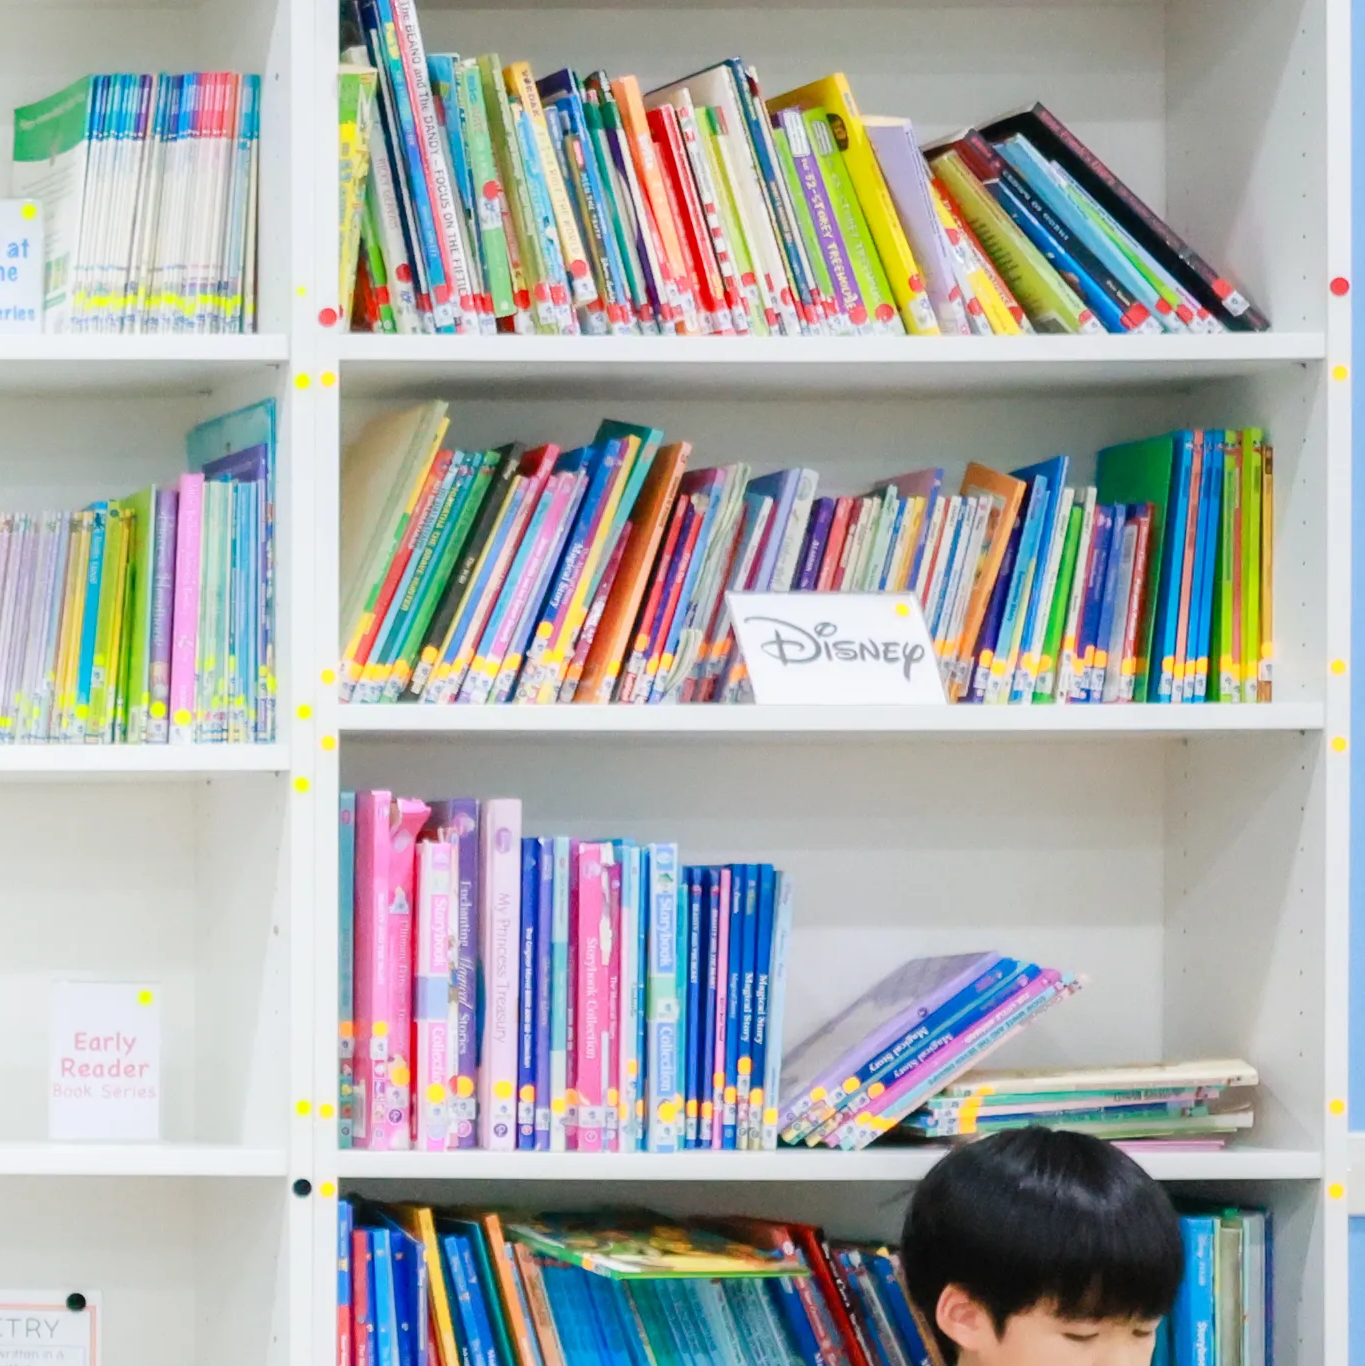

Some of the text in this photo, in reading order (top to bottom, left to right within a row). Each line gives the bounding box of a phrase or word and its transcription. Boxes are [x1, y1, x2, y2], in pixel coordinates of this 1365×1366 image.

[405, 25, 422, 65] BEANO
[412, 67, 424, 86] and
[417, 88, 429, 111] The
[422, 112, 437, 155] DANDY
[434, 168, 450, 210] FOCUS
[441, 212, 453, 227] ON
[7, 236, 30, 260] at
[445, 230, 458, 254] THE
[804, 172, 834, 239] 52-STOREY
[826, 242, 858, 310] TREEHOUSE
[449, 256, 467, 294] FIFTIE
[550, 543, 584, 610] Magical Story
[456, 880, 472, 1056] Enchanting Magical Stories
[492, 891, 511, 1044] My Princess Treasury
[430, 898, 447, 1085] Storybook Collectio
[584, 937, 598, 1059] Storybook Collection
[656, 897, 672, 1092] Storybook Collection
[739, 972, 752, 1042] Magical Story
[753, 974, 767, 1045] Magical Story
[74, 1031, 137, 1057] Early
[61, 1059, 150, 1079] Reader
[52, 1083, 157, 1100] Book Series
